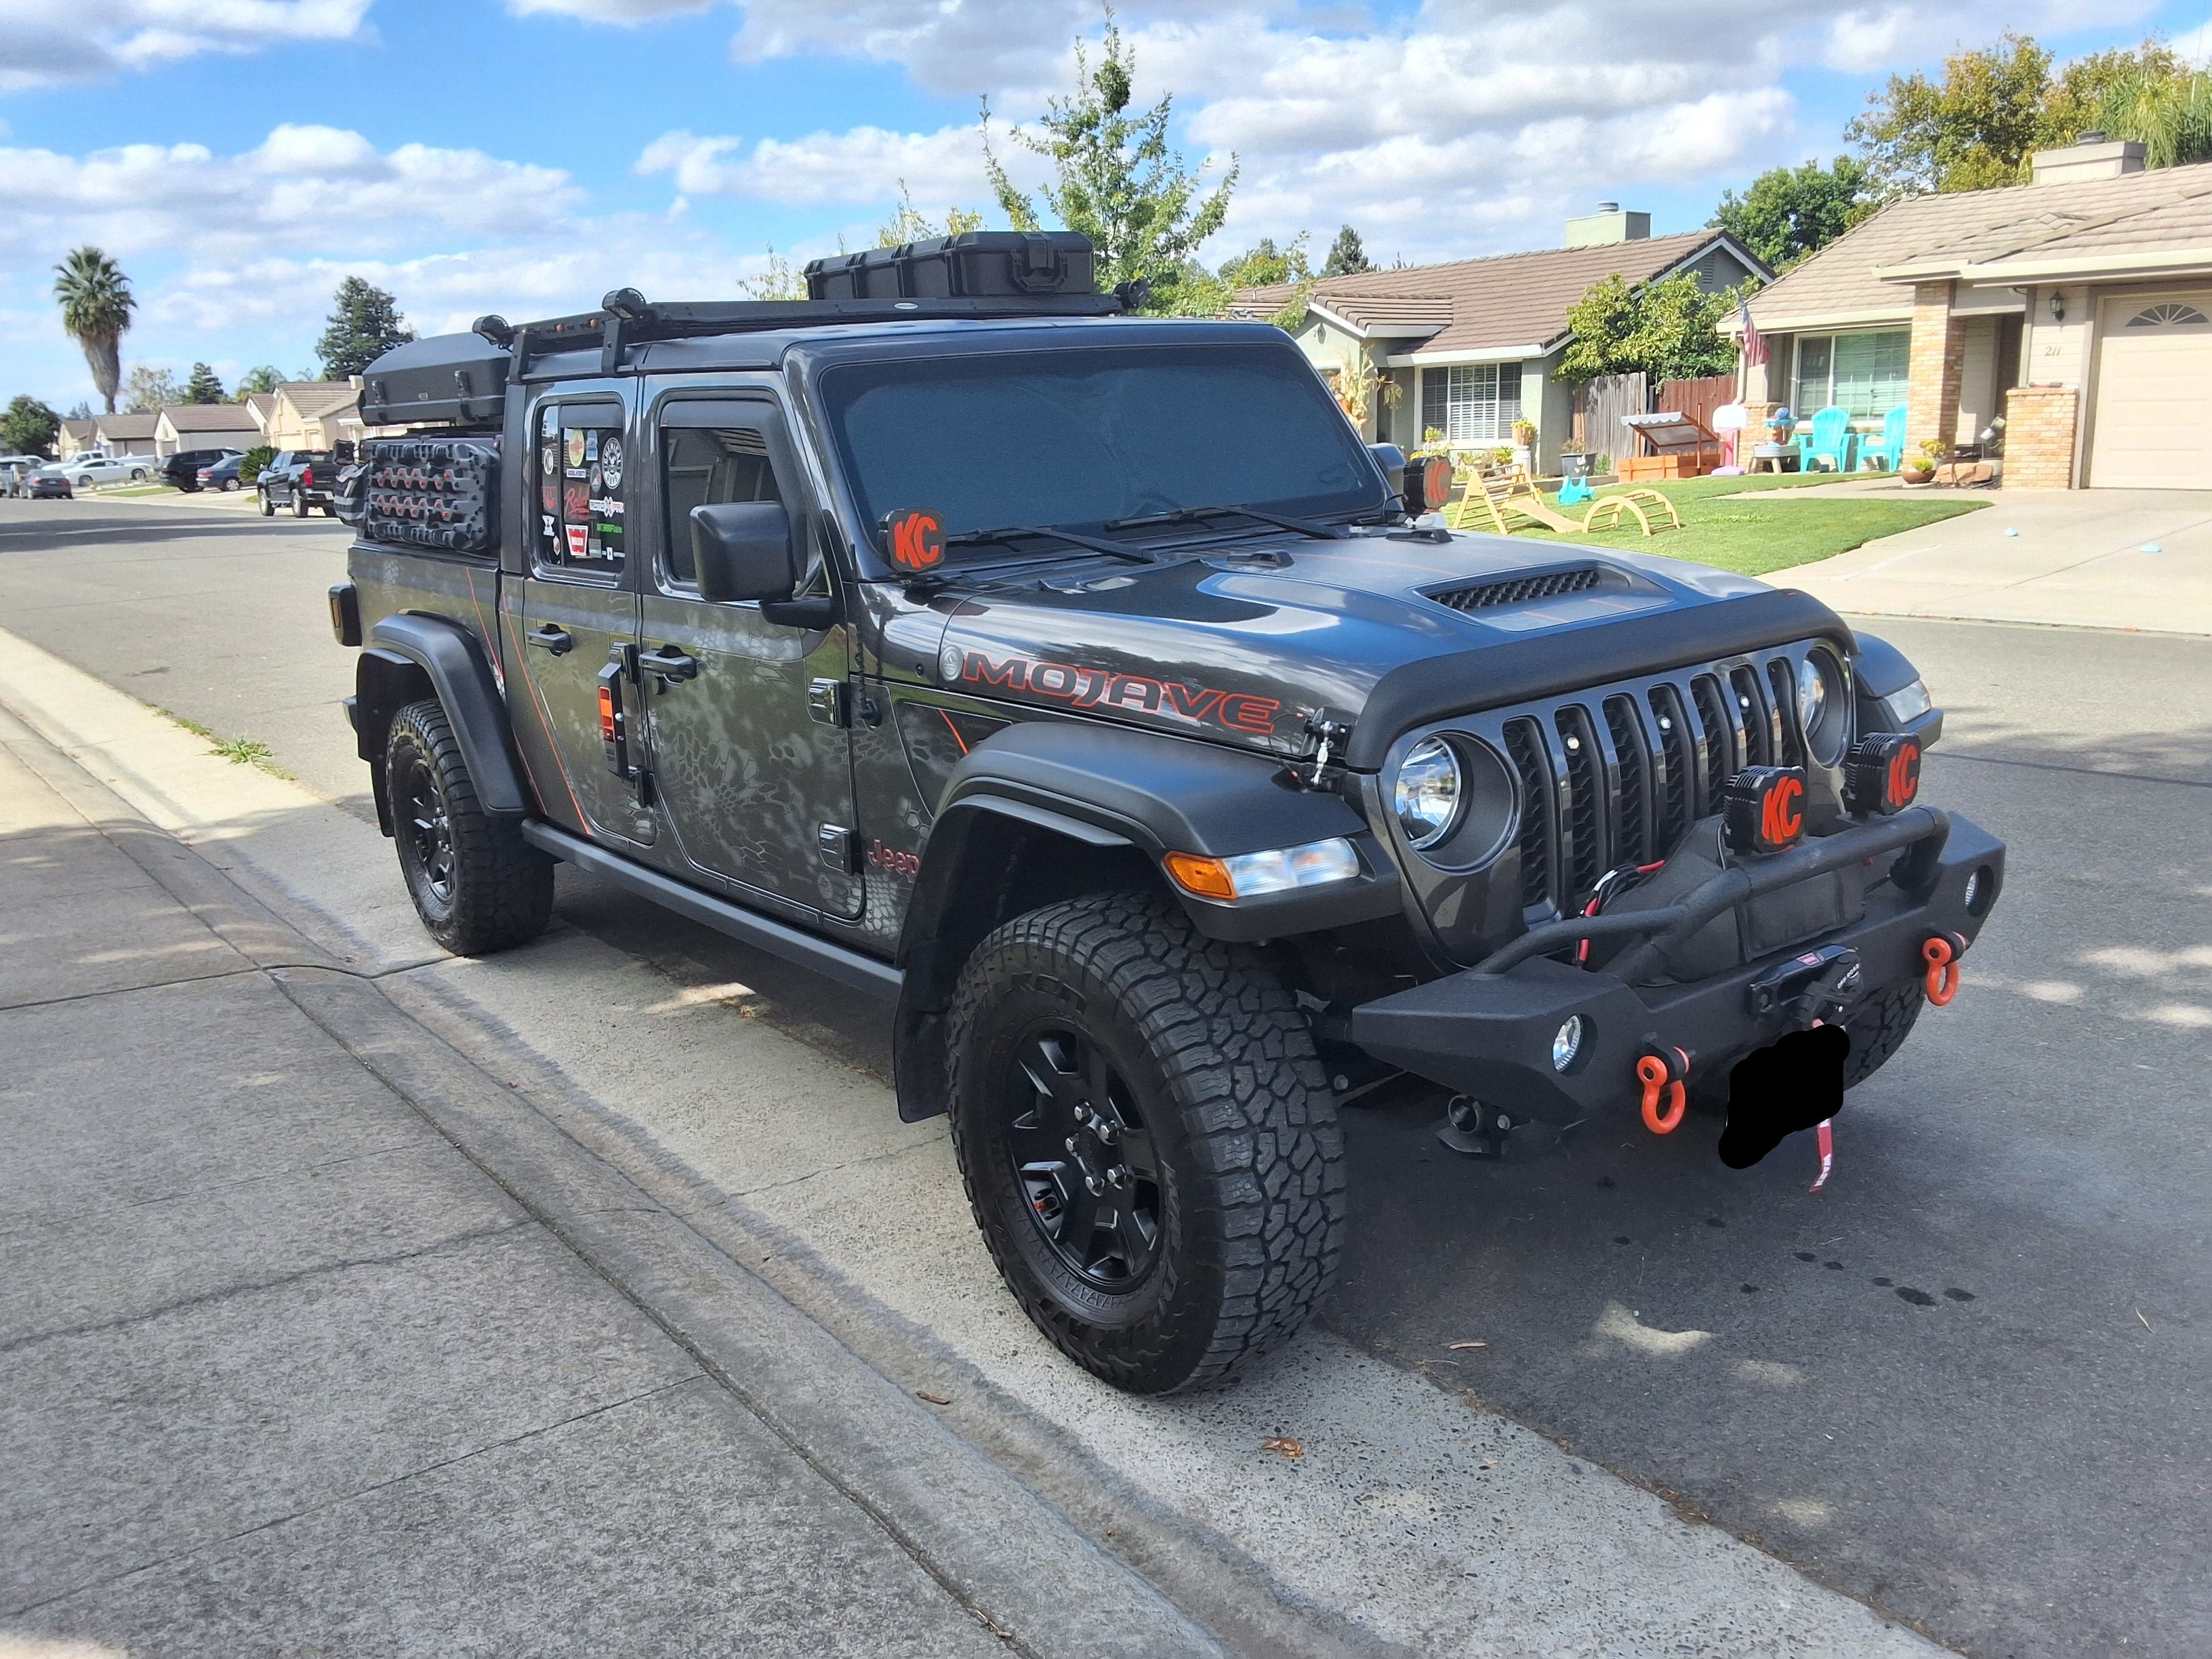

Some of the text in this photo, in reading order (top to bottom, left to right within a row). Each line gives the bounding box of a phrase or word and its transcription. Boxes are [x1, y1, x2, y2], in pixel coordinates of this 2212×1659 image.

[2044, 346, 2062, 356] 211
[1427, 460, 1449, 504] KC
[894, 513, 939, 569] KC
[962, 651, 1279, 734] MOJAVE
[1887, 743, 1918, 806] KC
[1761, 775, 1803, 844] KC
